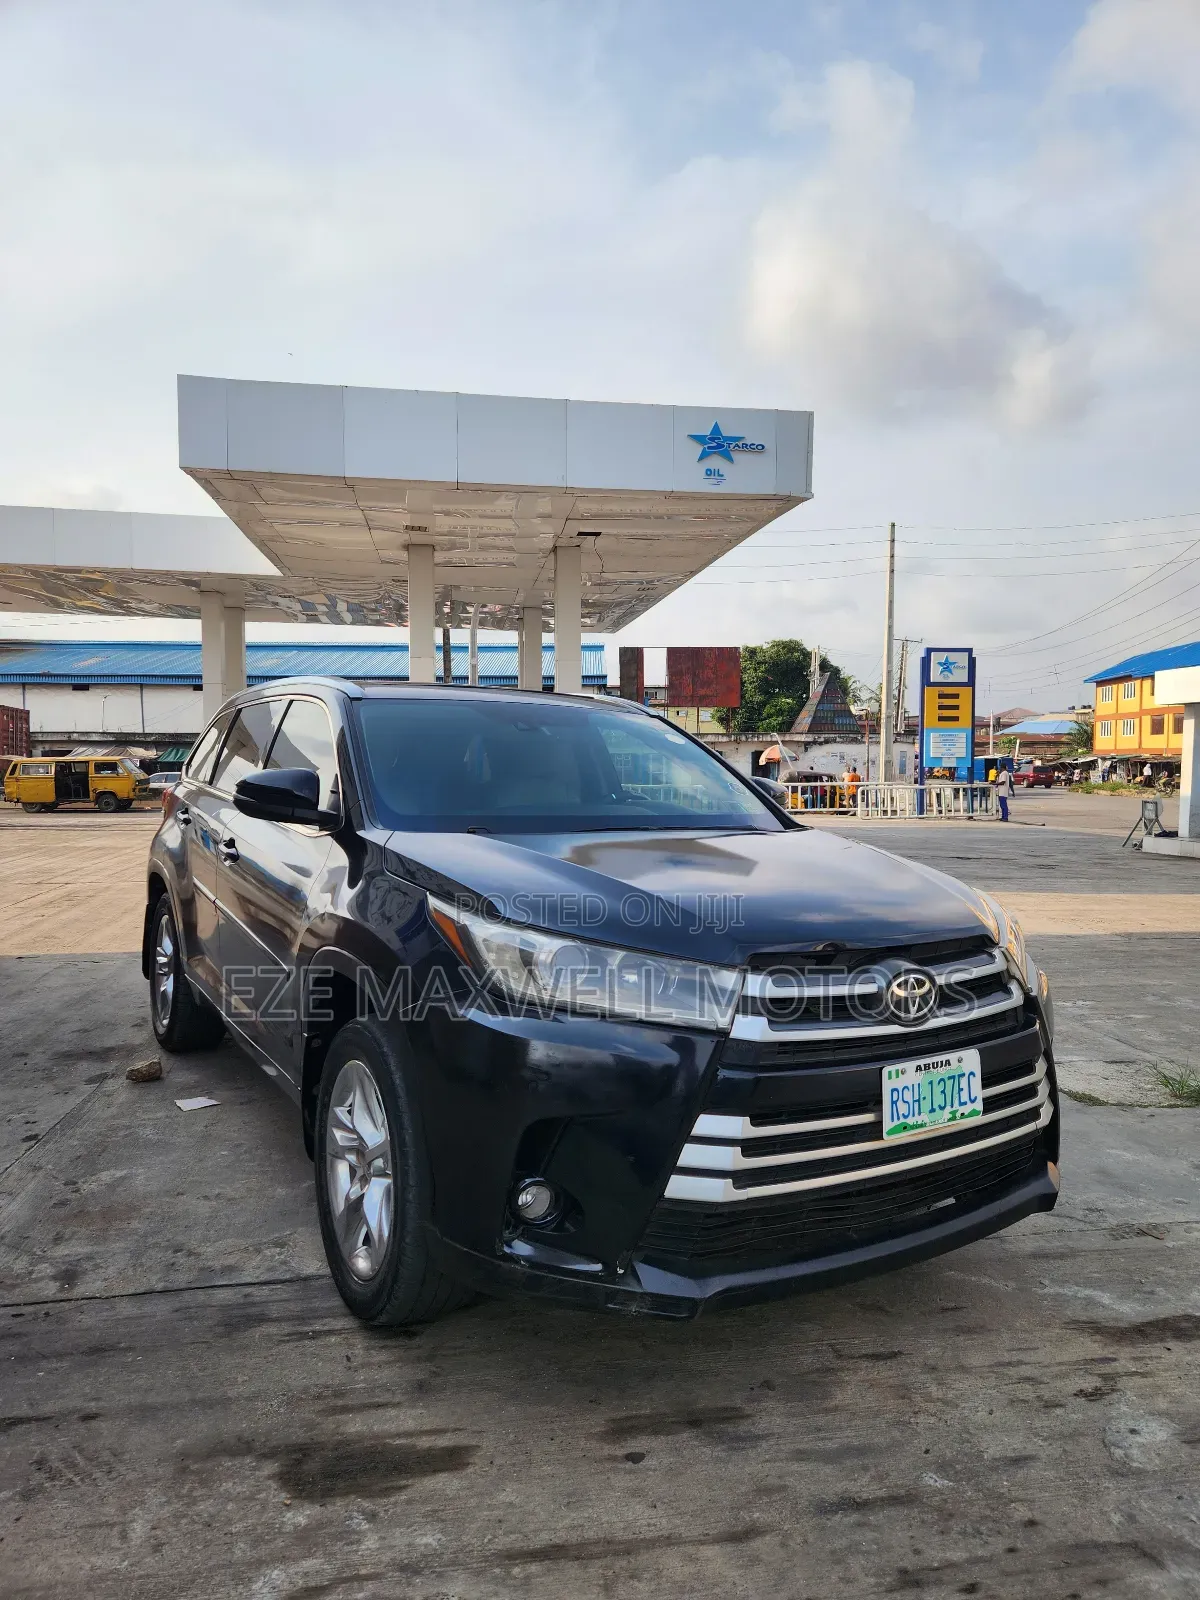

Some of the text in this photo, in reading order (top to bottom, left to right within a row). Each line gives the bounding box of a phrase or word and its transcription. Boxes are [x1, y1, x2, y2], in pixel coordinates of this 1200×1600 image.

[706, 436, 766, 451] STARCO
[705, 468, 724, 478] OIL
[915, 1059, 952, 1073] ABUJA
